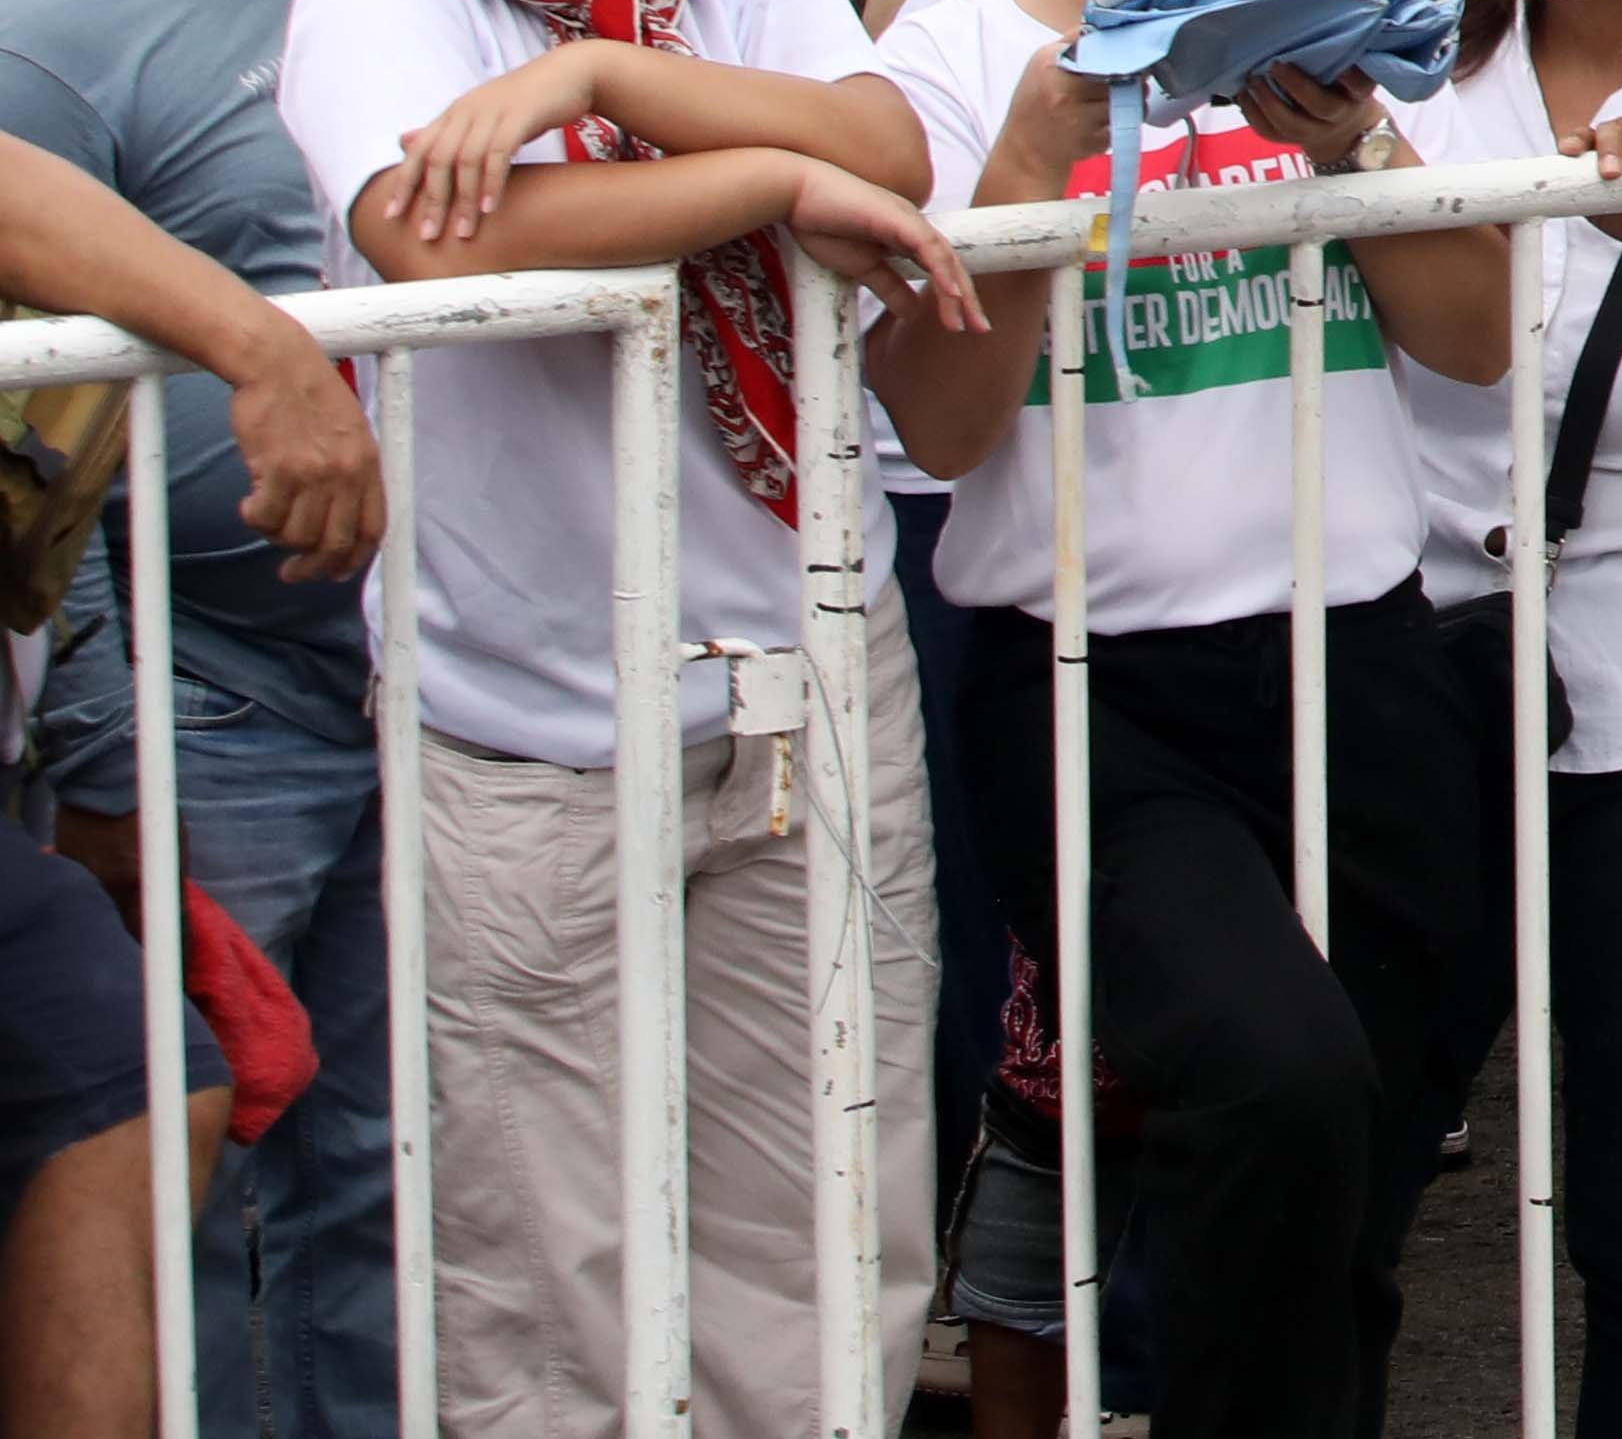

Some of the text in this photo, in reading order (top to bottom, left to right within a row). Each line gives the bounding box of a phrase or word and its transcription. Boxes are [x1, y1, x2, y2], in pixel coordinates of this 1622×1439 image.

[1169, 248, 1245, 284] FOR A
[1176, 262, 1373, 347] DEMOCAC
